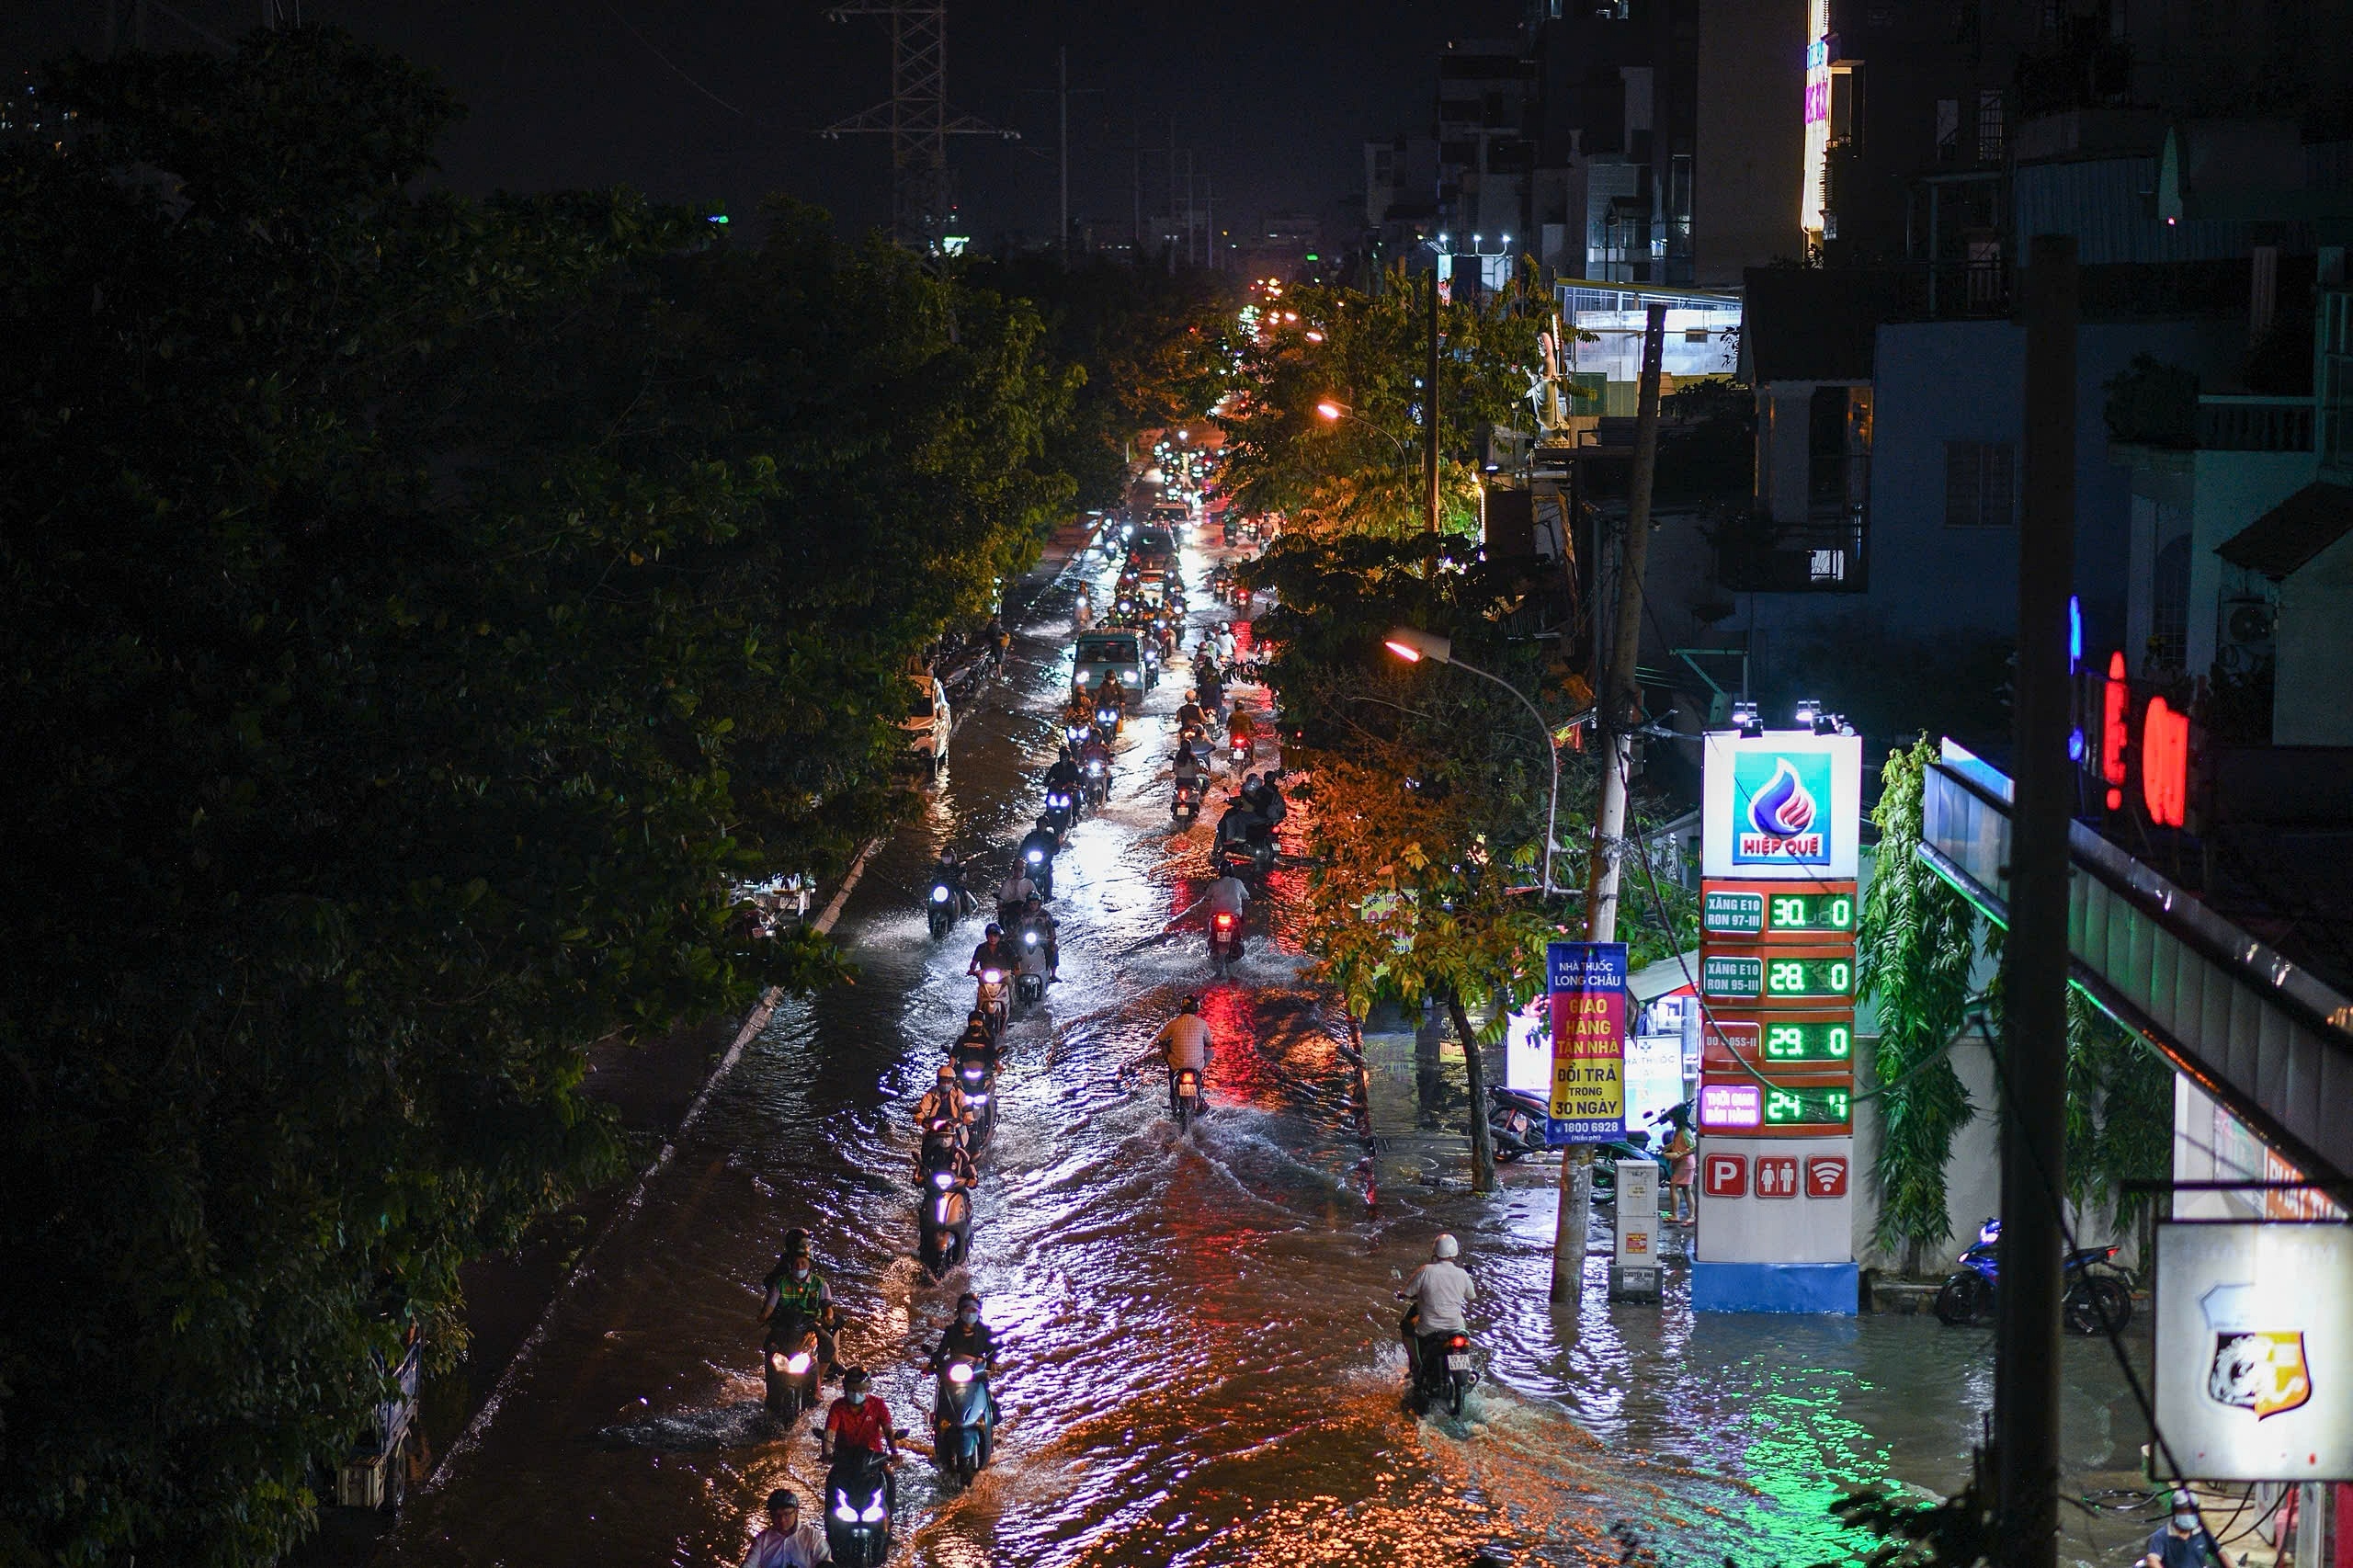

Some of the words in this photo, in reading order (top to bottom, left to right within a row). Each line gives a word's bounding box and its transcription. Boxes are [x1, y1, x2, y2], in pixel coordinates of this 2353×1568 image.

[1745, 835, 1781, 856] HIỆP
[1785, 836, 1818, 856] QUẾ
[1708, 897, 1737, 911] XĂNG
[1741, 899, 1759, 912] E10
[1708, 914, 1730, 926] RON
[1732, 915, 1759, 926] 97-III
[1559, 960, 1580, 971] NHÀ
[1582, 958, 1614, 971] THUỐC
[1708, 961, 1737, 975] XĂNG
[1739, 964, 1759, 976] E10
[1555, 976, 1586, 986] LONG
[1587, 973, 1620, 986] CHÂU
[1707, 979, 1728, 991] RON
[1732, 980, 1759, 991] 95-III
[1570, 998, 1607, 1013] GIAO
[1566, 1017, 1611, 1035] HÀNG
[1557, 1039, 1583, 1057] TẬN
[1586, 1039, 1620, 1054] NHÀ
[1557, 1062, 1581, 1082] ĐỔI
[1586, 1063, 1617, 1081] TRẢ
[1568, 1087, 1603, 1096] TRONG
[1555, 1102, 1573, 1115] 30
[1577, 1099, 1618, 1114] NGÀY
[1768, 1092, 1801, 1119] 24
[1563, 1123, 1588, 1132] 1800
[1591, 1121, 1619, 1132] 6928
[1714, 1162, 1737, 1189] P
